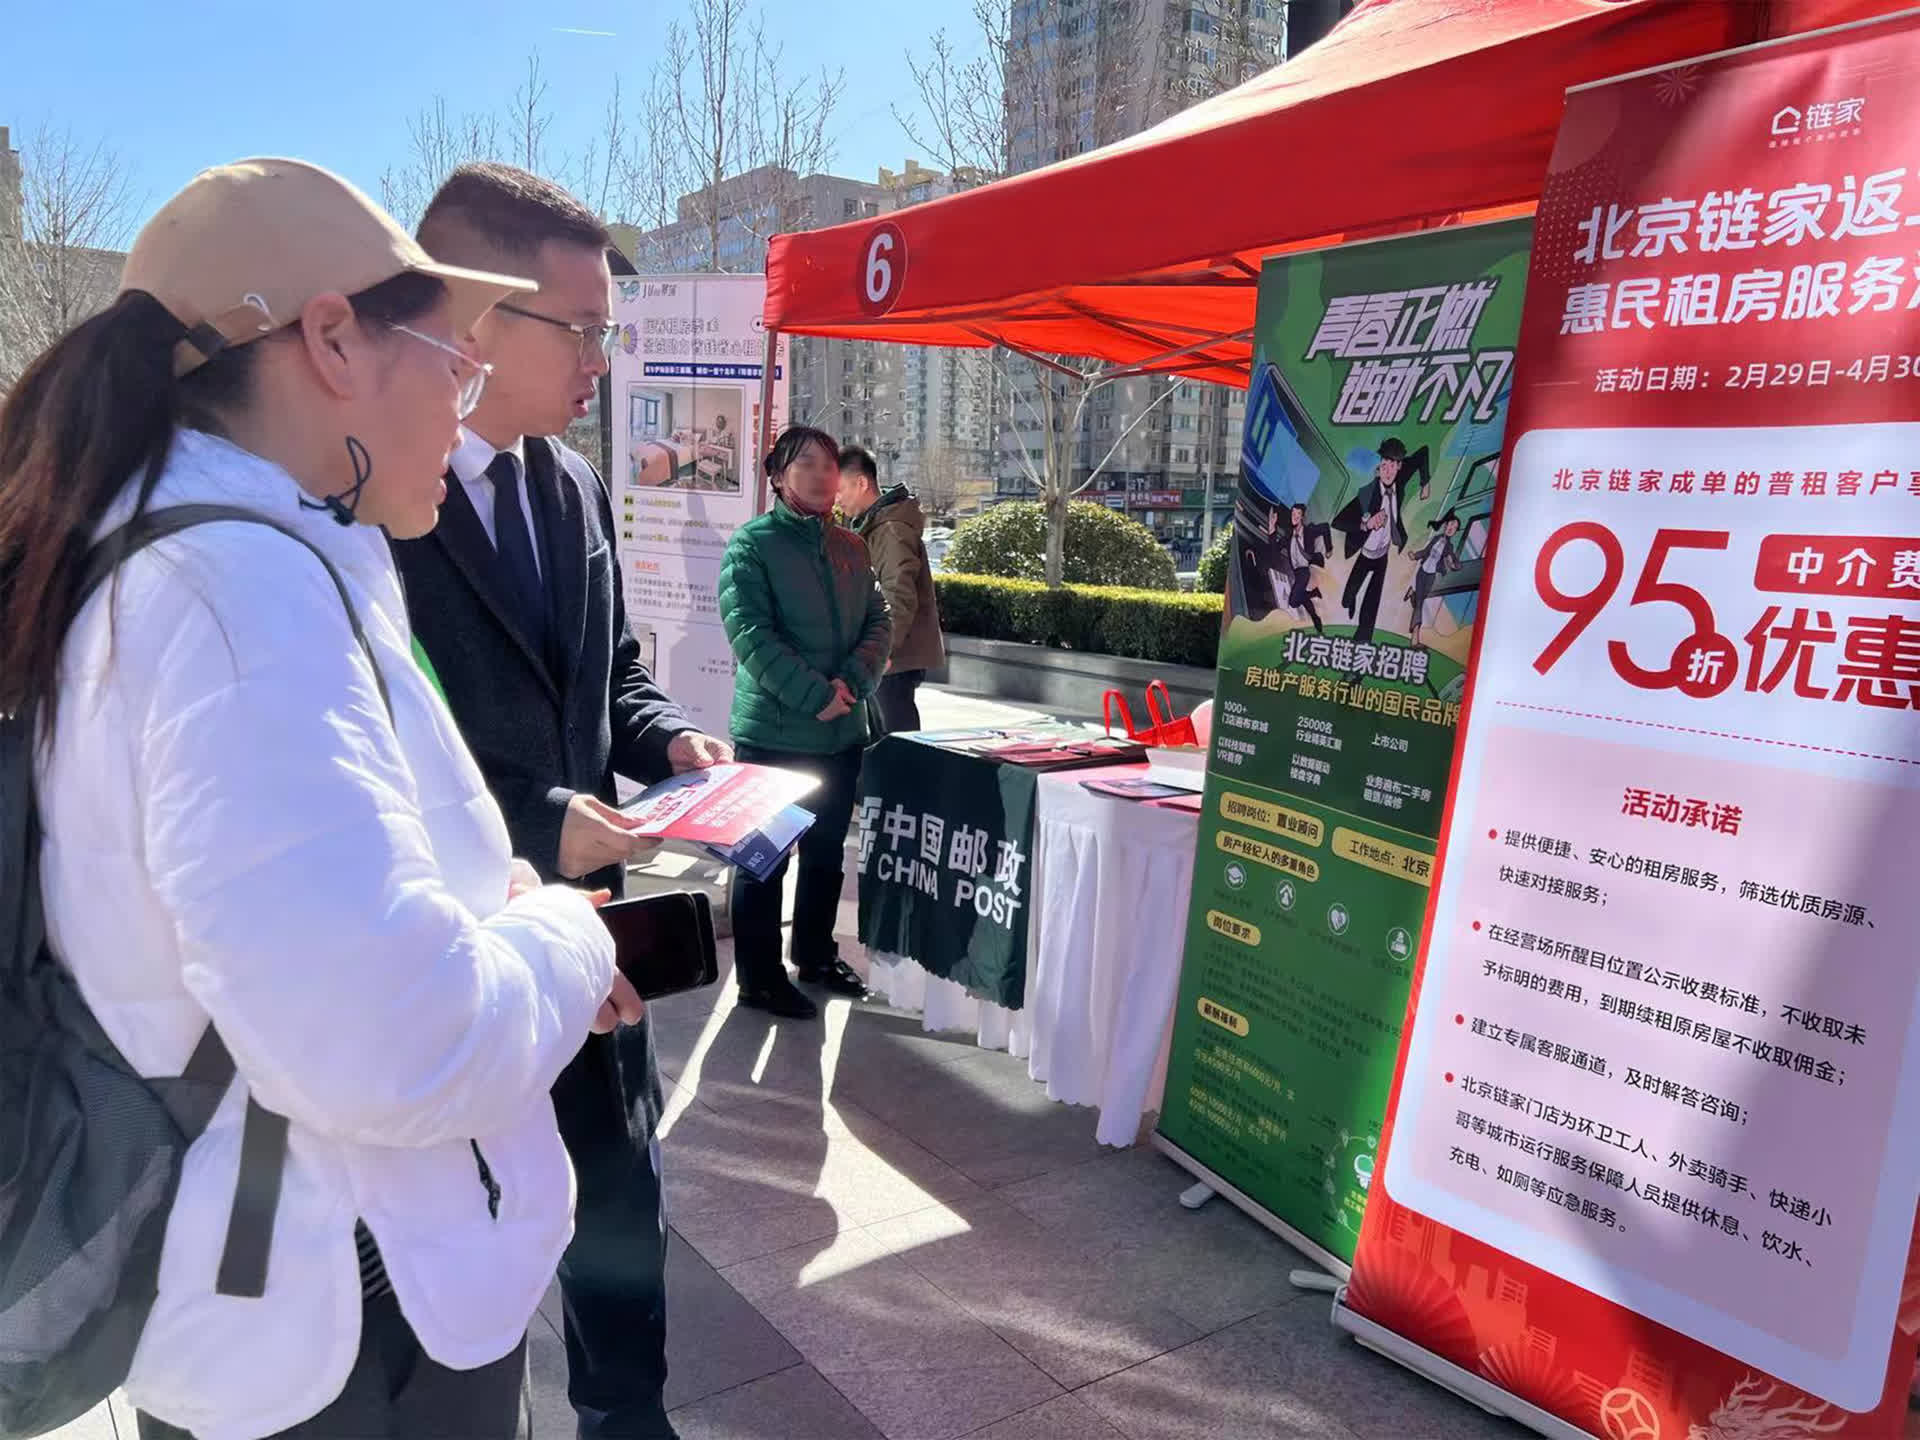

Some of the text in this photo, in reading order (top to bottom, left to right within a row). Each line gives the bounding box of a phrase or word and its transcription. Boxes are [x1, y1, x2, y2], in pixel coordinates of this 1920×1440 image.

[1806, 98, 1865, 130] 链家
[866, 233, 893, 302] 6
[1304, 279, 1498, 361] 青春正燃
[1331, 350, 1515, 424] 造就不凡
[1532, 521, 1730, 690] 95
[1787, 546, 1920, 590] 中介费
[1244, 665, 1460, 728] 房地产服务行业的国民品牌
[1282, 630, 1429, 686] 北京链家招聘
[1686, 648, 1724, 684] 折
[1743, 605, 1920, 711] 优惠
[1372, 732, 1408, 752] 上市公司
[883, 803, 1026, 896] 中国邮政
[1621, 786, 1743, 836] 活动承诺
[878, 853, 1021, 930] CHINA POST
[1499, 865, 1608, 907] 快速对接服务；
[1504, 828, 1875, 929] 提供便捷、安心的租房服务，筛选优质房源、
[1483, 959, 1848, 1087] 予标明的费用，到期续租原房屋不收取佣金；
[1488, 923, 1867, 1045] 在经营场所醒目位置公示收费标准，不收取未
[1471, 1016, 1750, 1126] 建立专属客服通道，及时解答咨询；
[1449, 1145, 1626, 1233] 充电、如厕等应急服务。
[1455, 1109, 1813, 1268] 哥等城市运行服务保障人员提供休息、饮水、
[1461, 1075, 1833, 1228] 北京链家门店为环卫工人、外卖骑手、快递小
